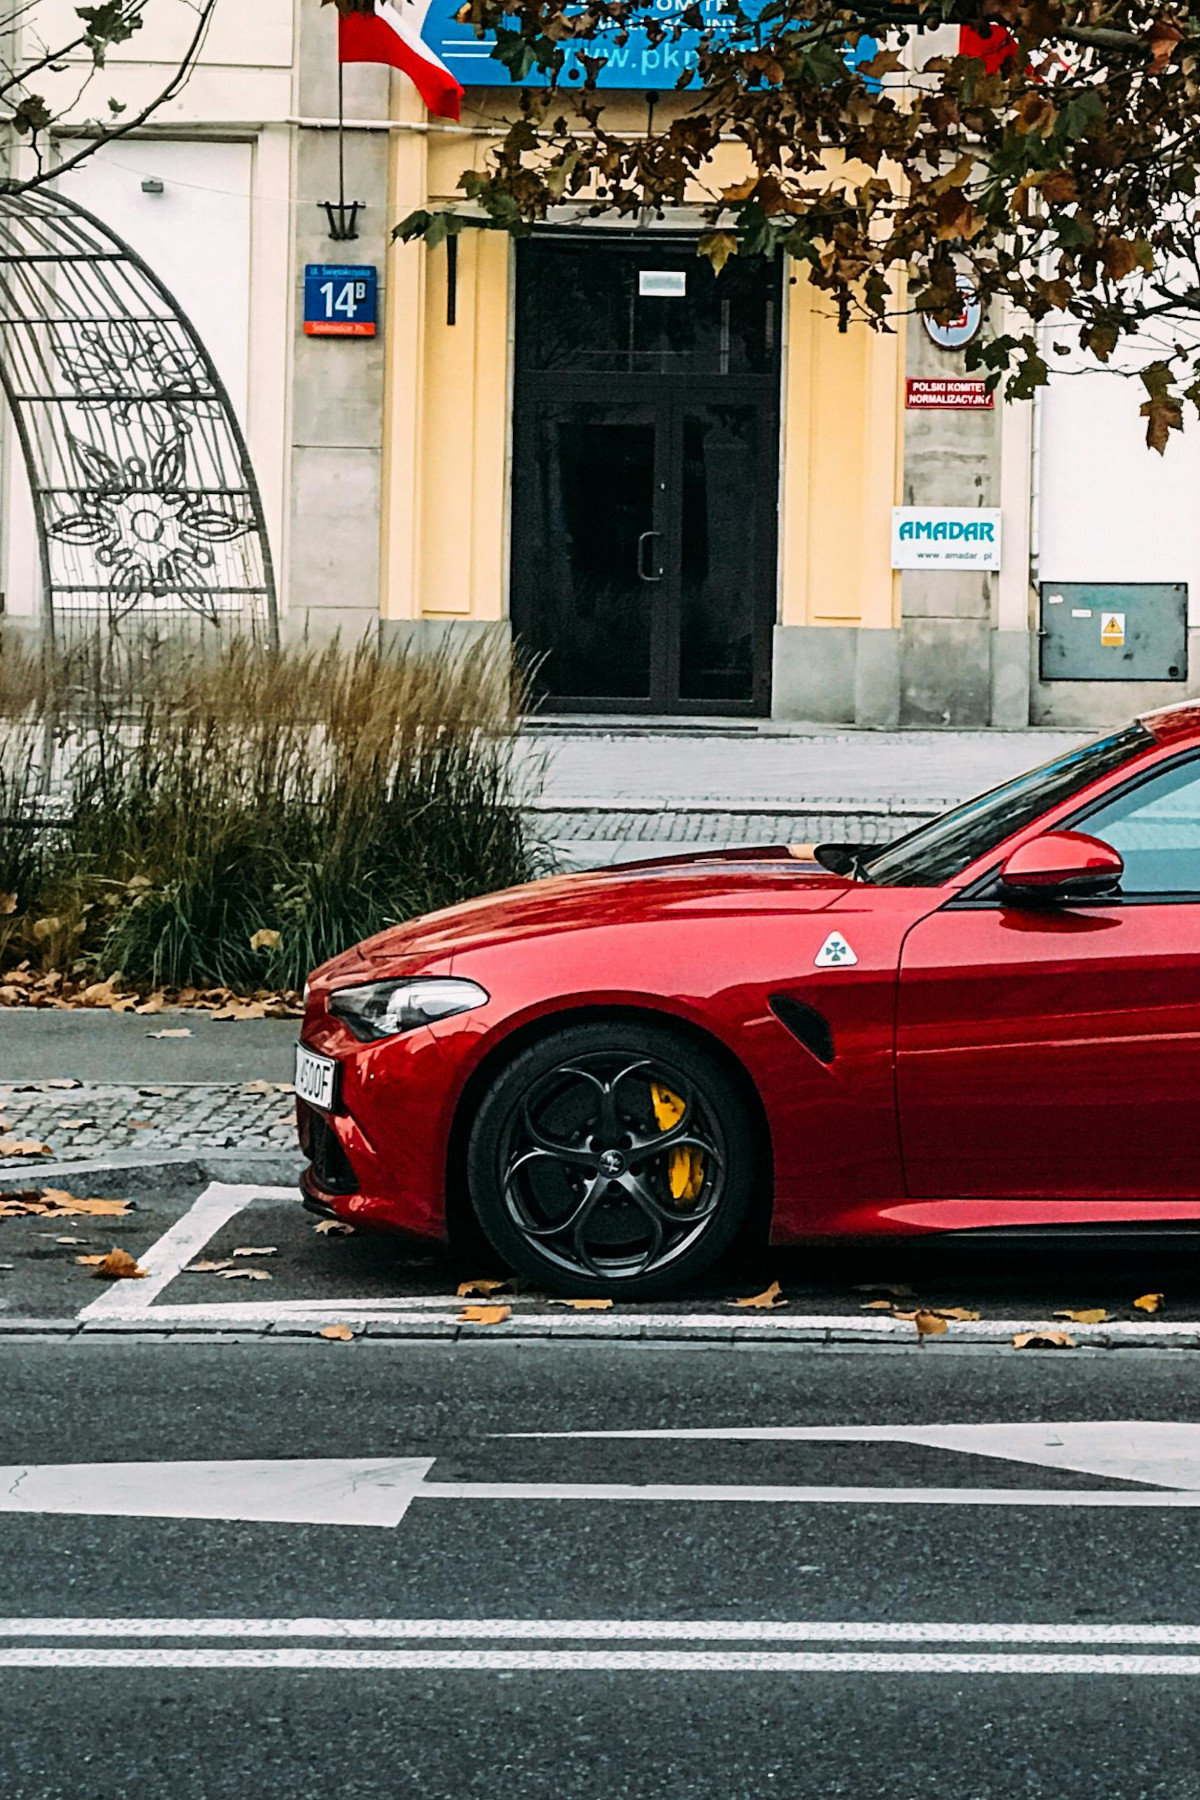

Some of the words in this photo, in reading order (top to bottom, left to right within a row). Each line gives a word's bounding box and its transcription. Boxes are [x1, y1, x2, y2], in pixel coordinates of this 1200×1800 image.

[912, 382, 946, 392] POLSKI
[908, 394, 991, 405] NORMALIZACYJNY
[898, 521, 995, 542] AMADAR
